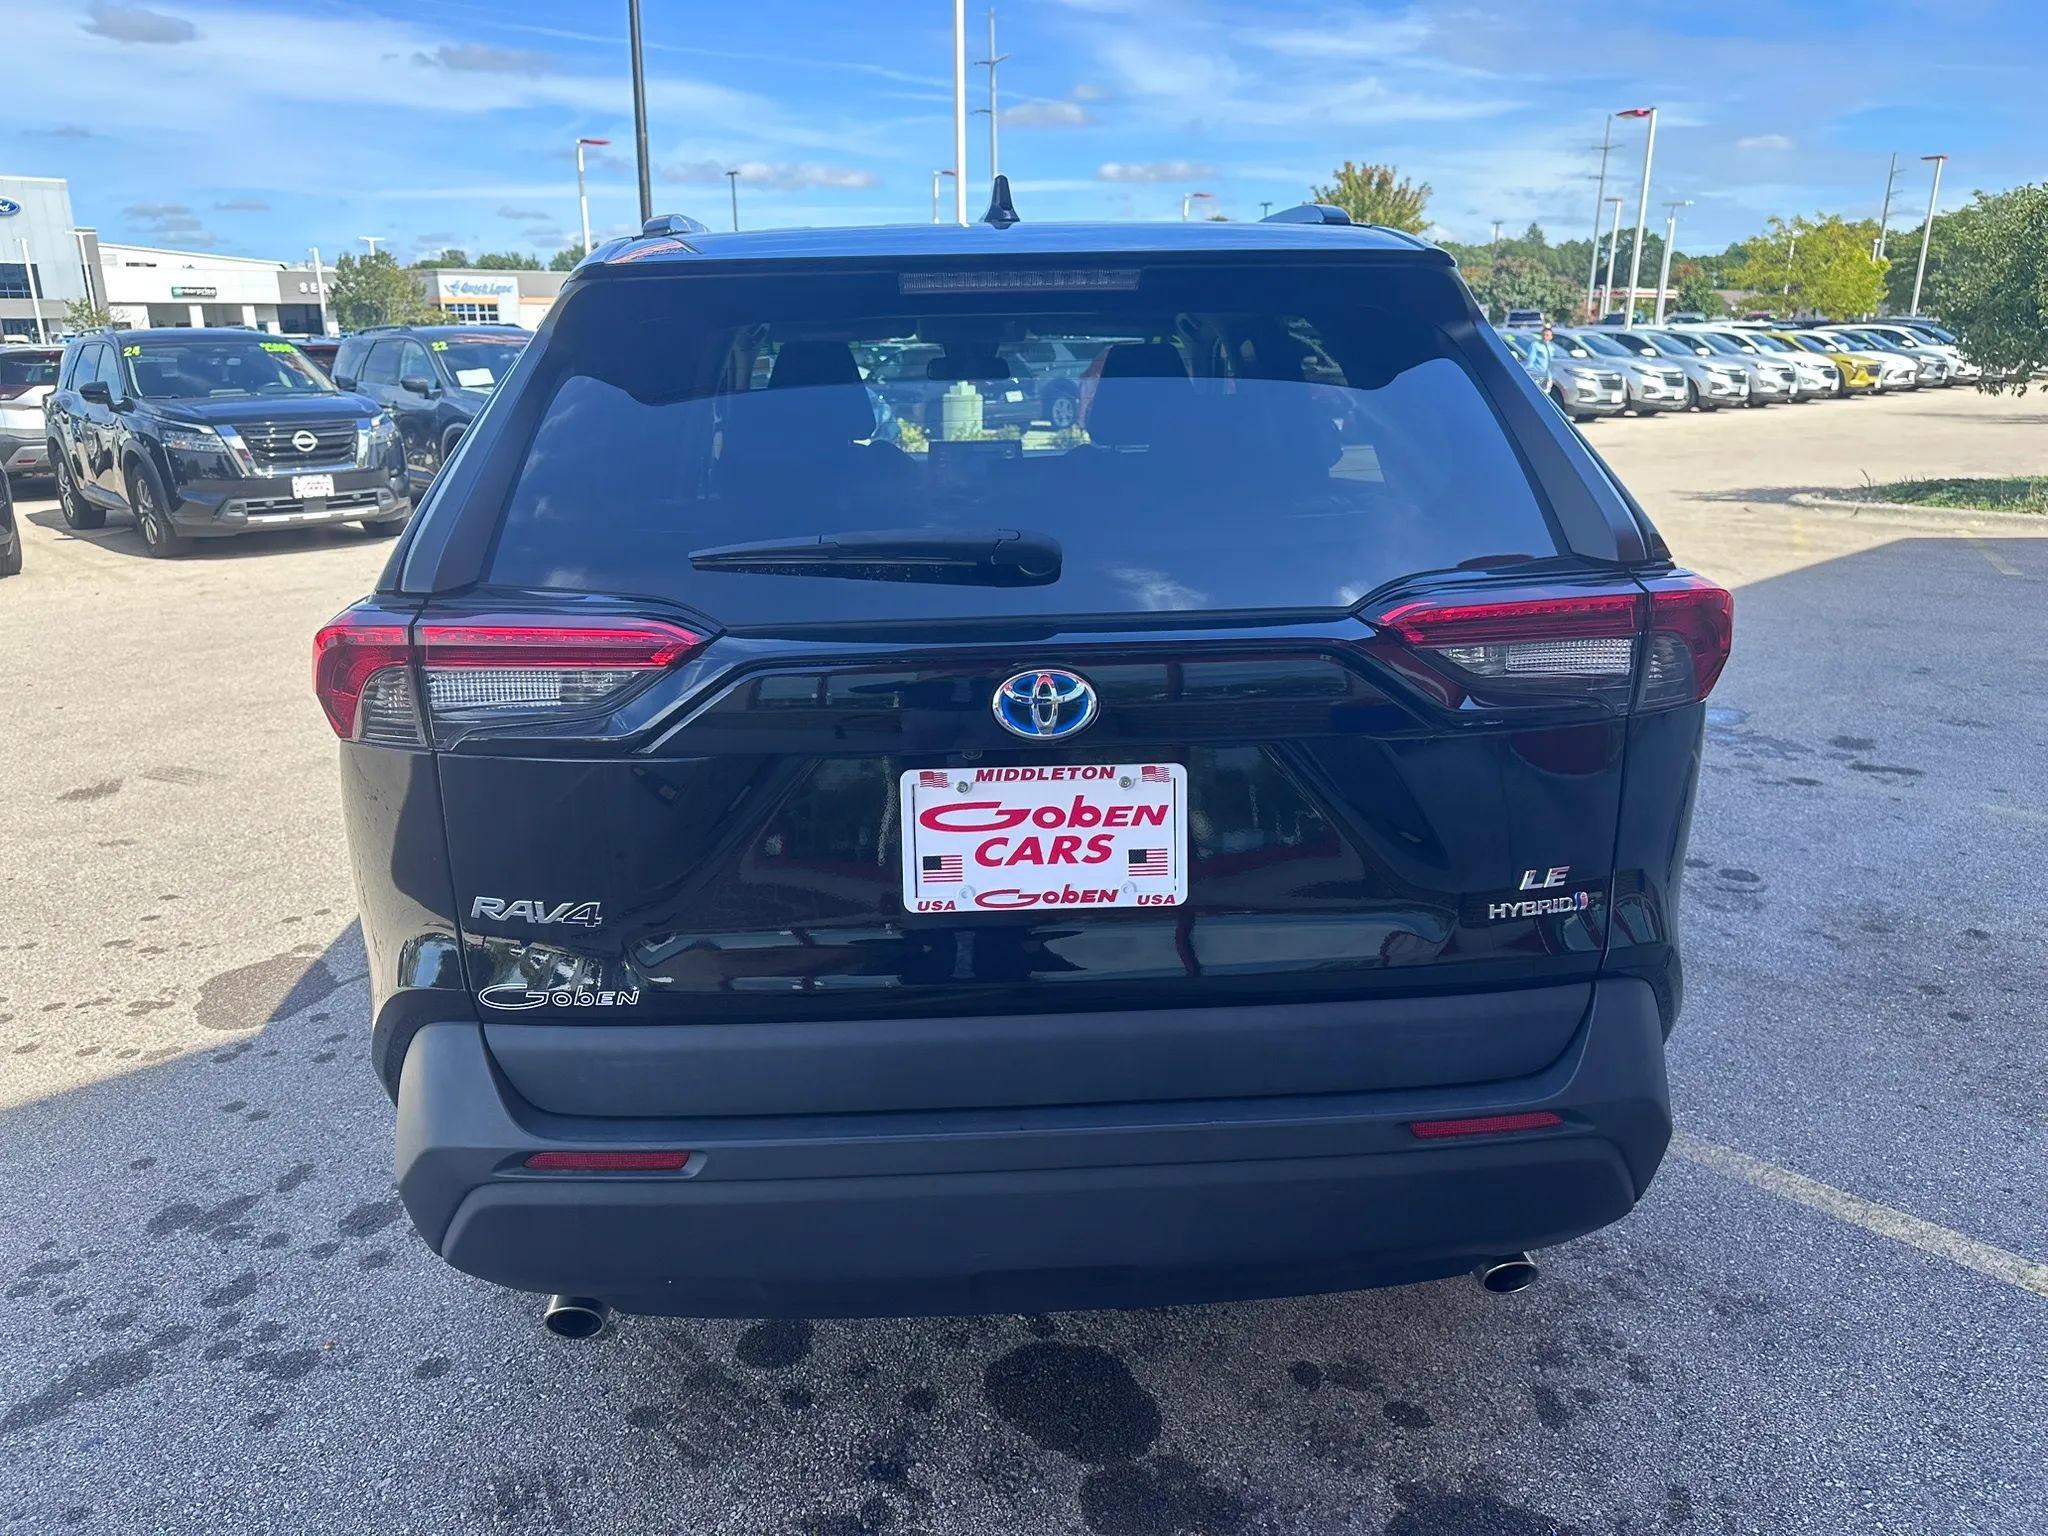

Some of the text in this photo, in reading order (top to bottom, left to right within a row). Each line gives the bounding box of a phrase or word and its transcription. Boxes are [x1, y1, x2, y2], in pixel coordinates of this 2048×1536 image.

[123, 345, 140, 356] 24
[431, 340, 448, 351] 22
[975, 766, 1116, 782] MIDDLETON
[974, 833, 1115, 867] CARS
[1519, 866, 1570, 890] LE
[471, 896, 603, 927] RAV4
[917, 900, 956, 911] USA
[1137, 894, 1176, 905] USA
[1489, 897, 1574, 919] HYBRID
